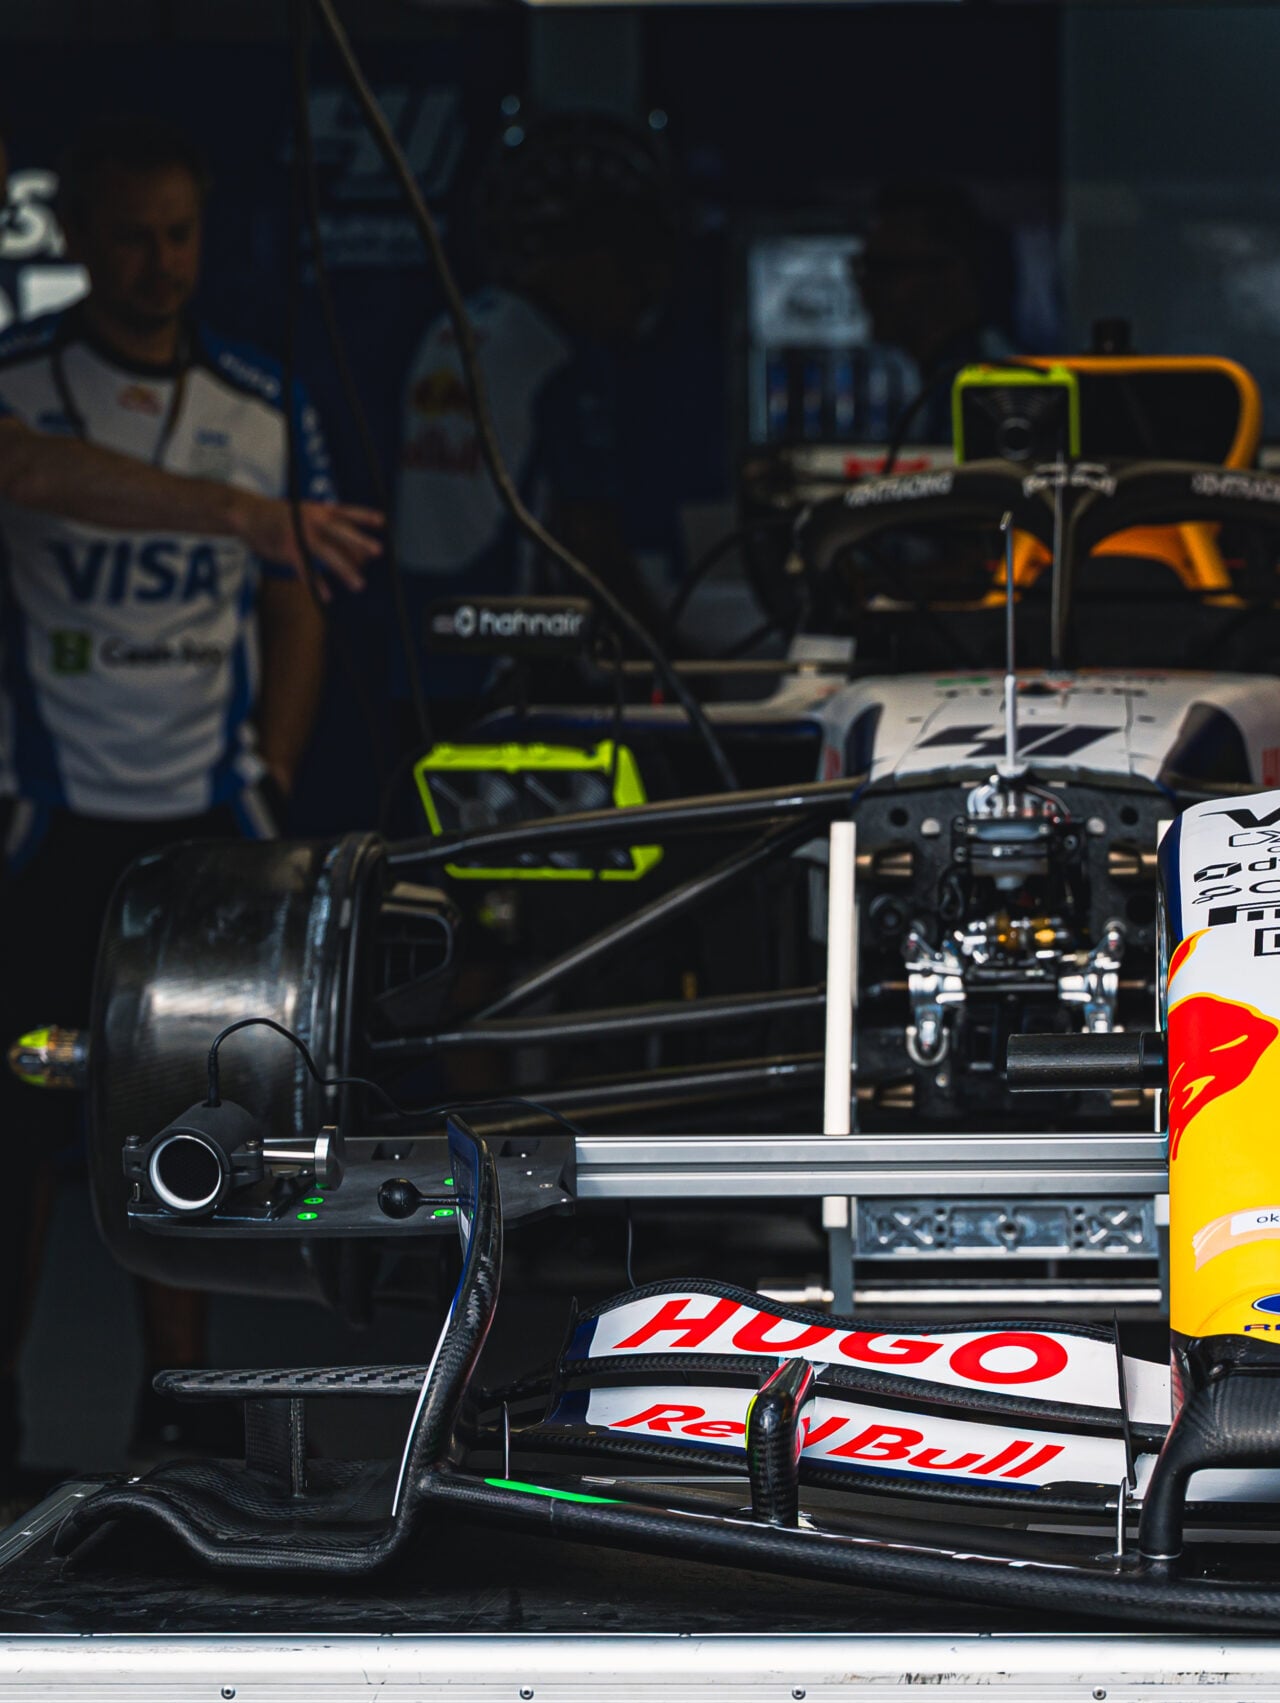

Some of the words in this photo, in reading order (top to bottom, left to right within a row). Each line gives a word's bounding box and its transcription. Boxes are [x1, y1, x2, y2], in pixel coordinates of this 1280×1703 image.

[48, 541, 220, 603] VISA
[479, 607, 583, 638] hahnair
[1256, 1213, 1279, 1224] ok
[612, 1298, 1068, 1385] HUGO
[826, 1425, 1066, 1479] Bull
